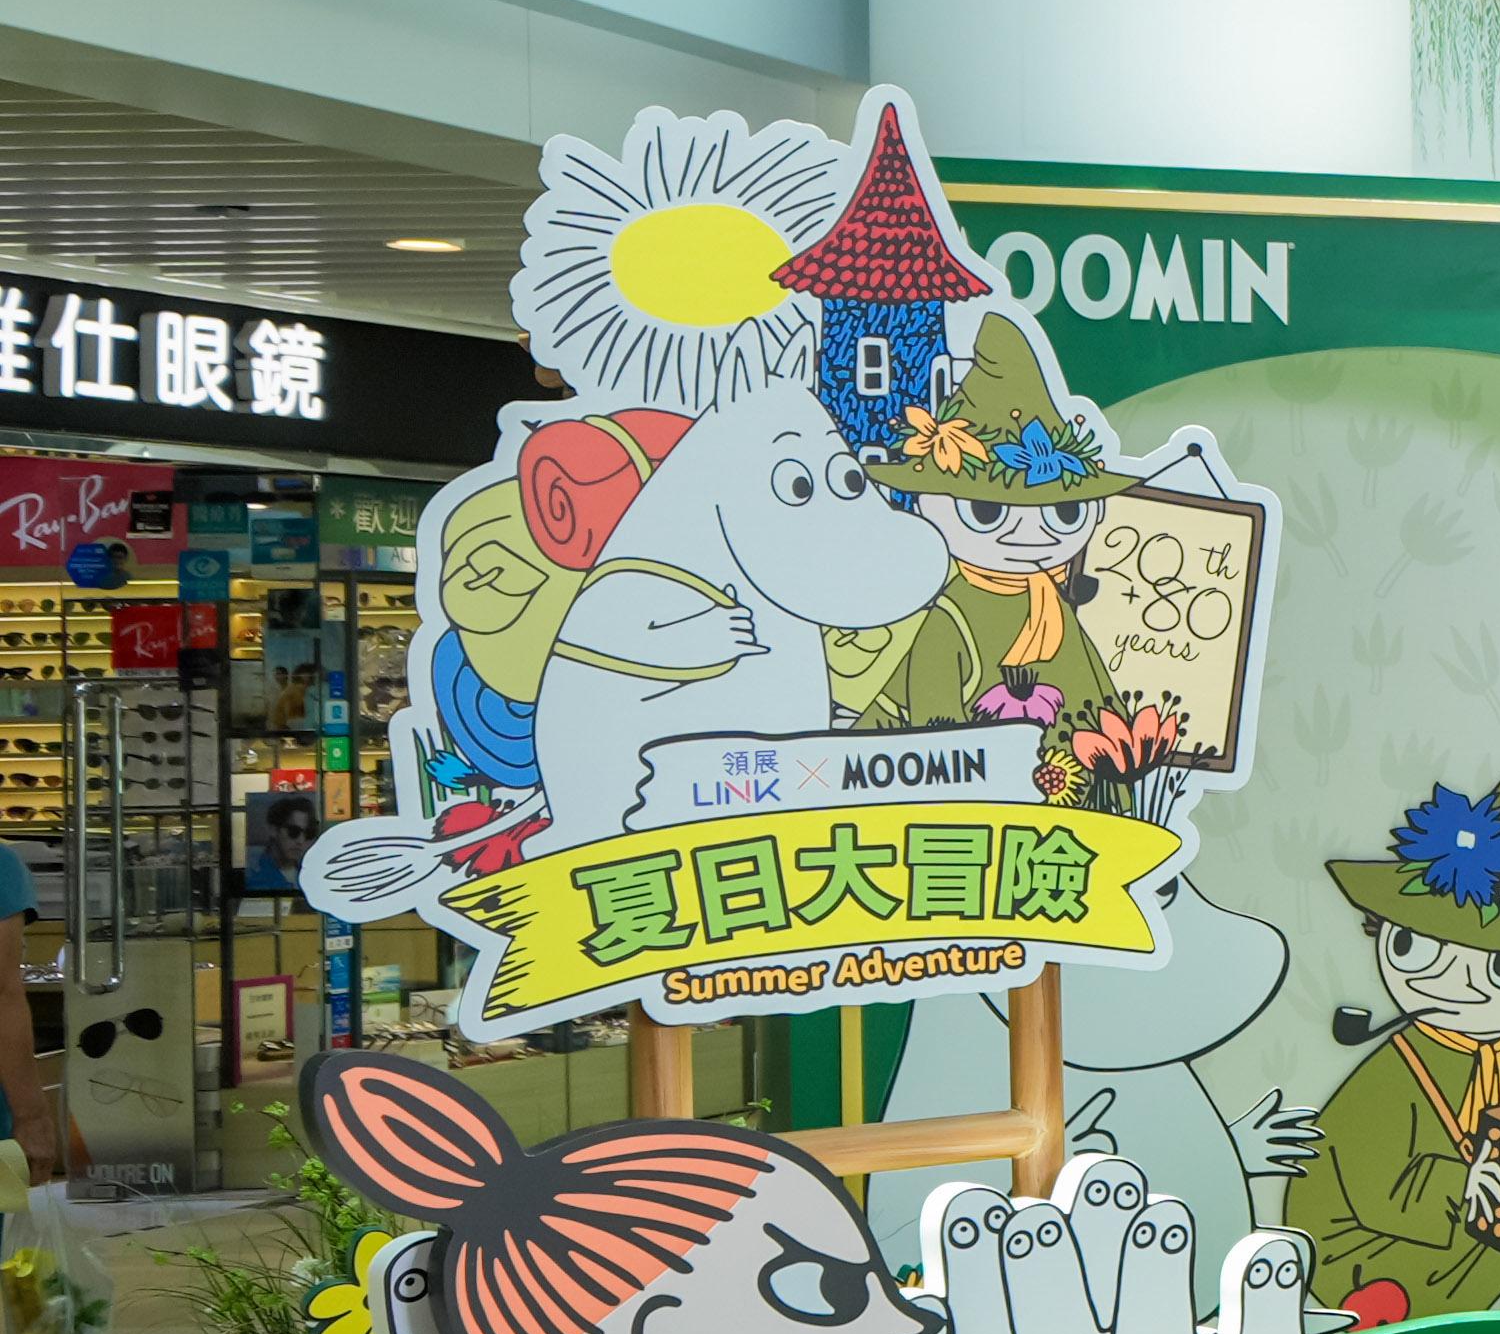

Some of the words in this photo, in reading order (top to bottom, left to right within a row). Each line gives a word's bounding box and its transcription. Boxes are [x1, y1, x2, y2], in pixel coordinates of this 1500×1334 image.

[963, 230, 1289, 326] OOMIN
[1108, 633, 1200, 672] years
[692, 778, 781, 807] LINK
[841, 748, 987, 791] MOOMIN
[721, 750, 780, 776] 領展
[570, 823, 1100, 967] 夏日大冒險
[662, 960, 829, 1004] Summer
[833, 940, 1027, 987] Adventure
